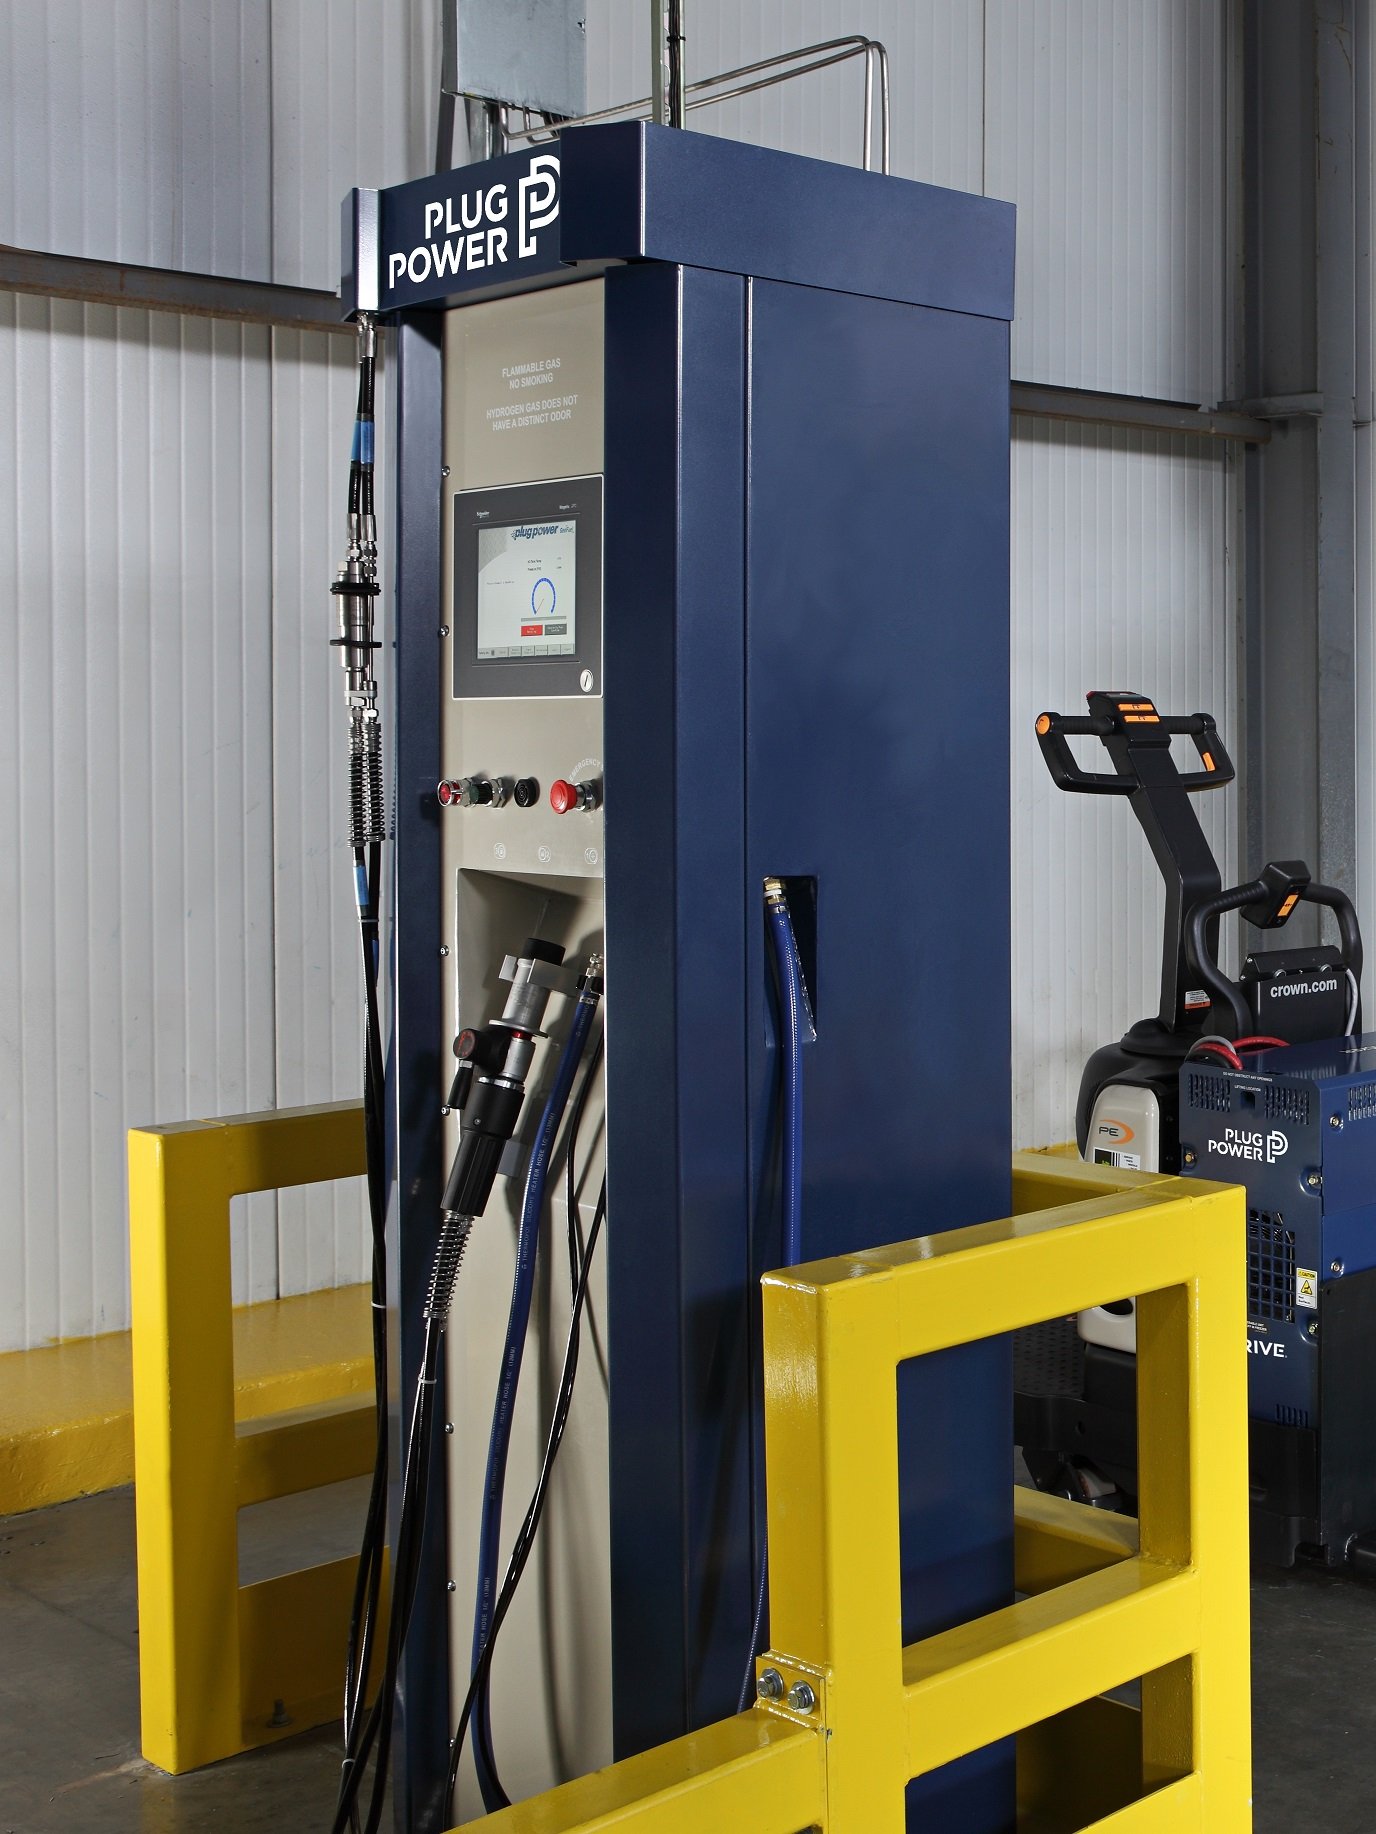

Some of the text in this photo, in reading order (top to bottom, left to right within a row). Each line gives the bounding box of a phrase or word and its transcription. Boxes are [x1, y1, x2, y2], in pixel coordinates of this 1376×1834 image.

[424, 183, 508, 239] PLUG
[388, 226, 508, 290] POWER
[502, 358, 561, 378] FLAMMABLE GAS
[509, 372, 554, 390] NO SMOKING
[486, 394, 578, 419] HYDROGEN GAS DOES NOT
[492, 409, 572, 431] HAVE A DISTINCT ODOR
[568, 758, 601, 782] EMERGENCY
[1270, 979, 1338, 998] crown.com
[1099, 1126, 1119, 1137] PE
[1225, 1128, 1263, 1147] PLUG
[1208, 1139, 1263, 1161] POWER
[530, 1168, 540, 1193] HEATER
[536, 1149, 545, 1167] HOSE
[1246, 1339, 1286, 1358] RIVE
[503, 1382, 511, 1399] HOSE
[499, 1400, 508, 1424] HEATER
